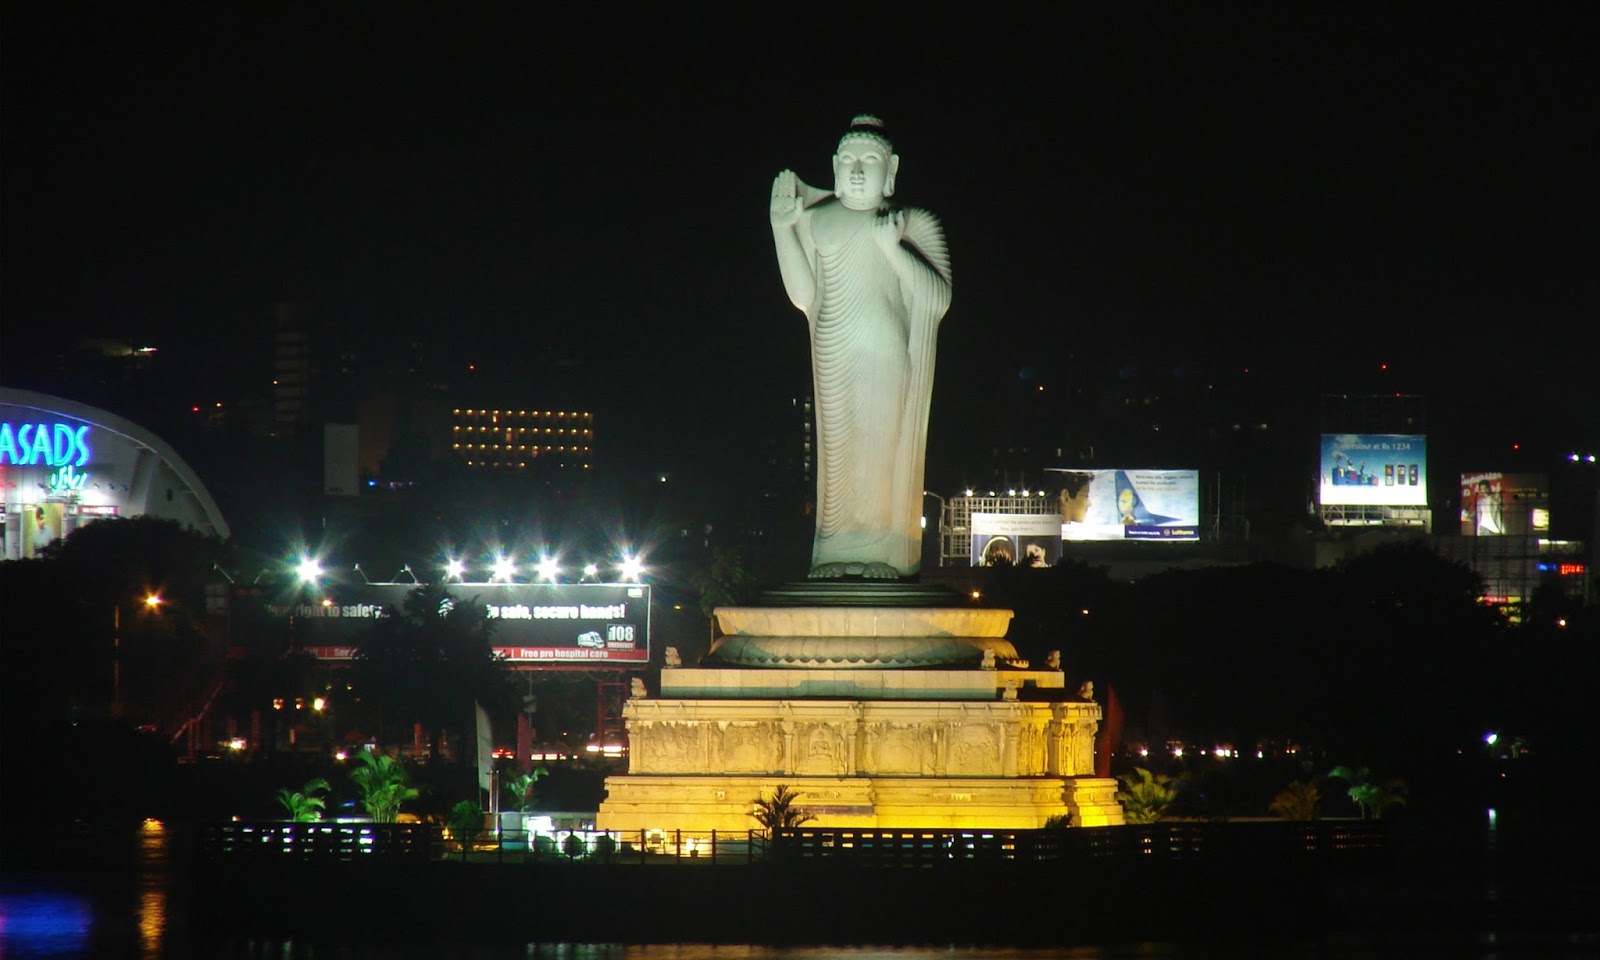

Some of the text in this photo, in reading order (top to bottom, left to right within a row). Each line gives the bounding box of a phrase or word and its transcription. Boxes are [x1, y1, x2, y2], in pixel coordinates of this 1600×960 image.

[0, 422, 91, 467] ASADS
[1392, 442, 1411, 450] 1234
[296, 603, 325, 619] right
[326, 604, 340, 618] to
[533, 605, 579, 619] secure
[609, 625, 634, 642] 108
[520, 650, 609, 659] Free pre hospital care
